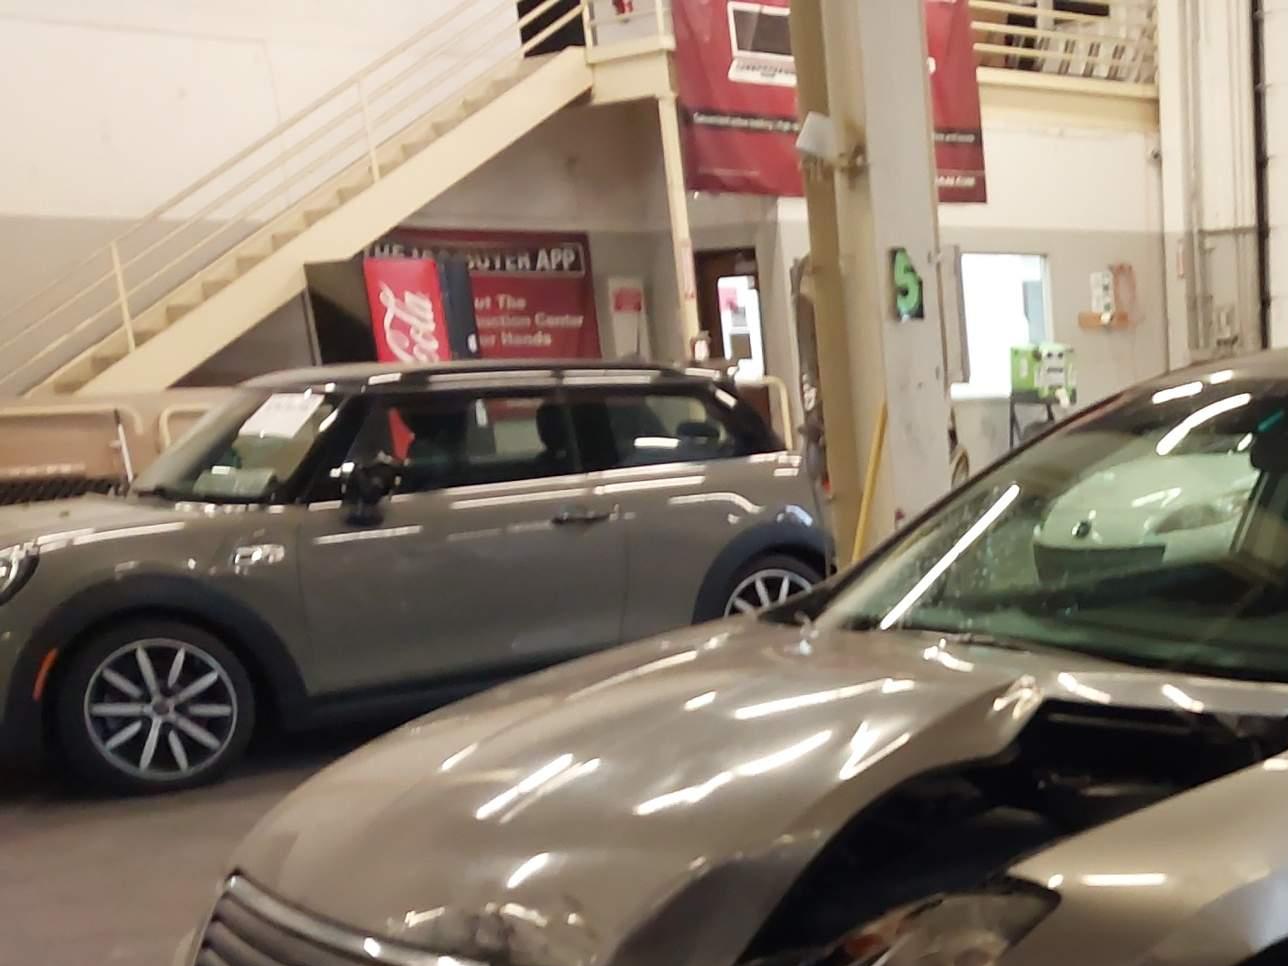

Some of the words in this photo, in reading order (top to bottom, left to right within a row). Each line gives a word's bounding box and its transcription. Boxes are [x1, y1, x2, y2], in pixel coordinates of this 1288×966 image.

[536, 248, 577, 271] APP
[894, 249, 919, 315] 5
[497, 293, 527, 311] The
